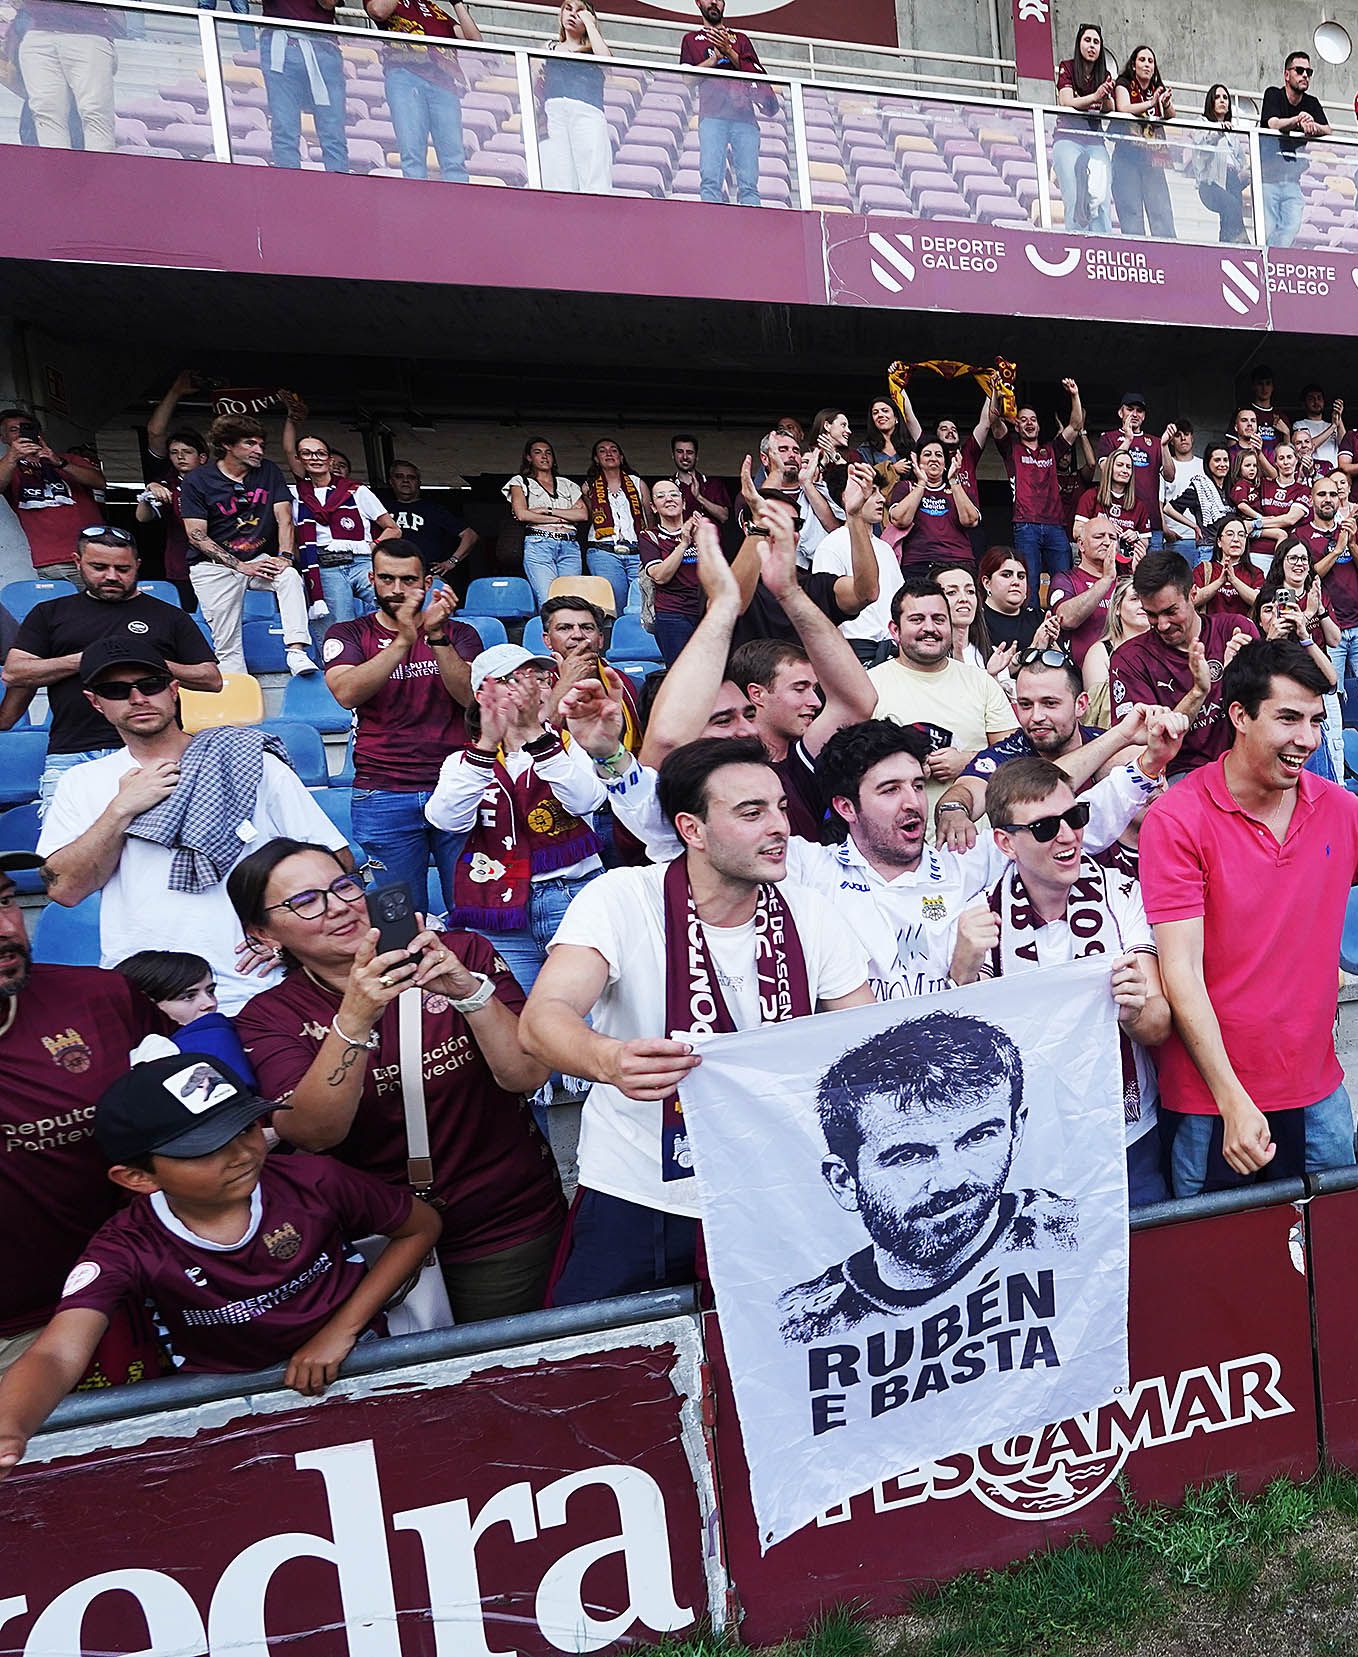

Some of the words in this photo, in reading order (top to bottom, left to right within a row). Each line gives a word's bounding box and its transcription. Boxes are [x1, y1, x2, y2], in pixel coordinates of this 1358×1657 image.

[921, 236, 1006, 257] DEPORTE
[922, 253, 999, 274] GALEGO
[1085, 248, 1147, 269] GALICIA
[1087, 264, 1166, 285] SAUDABLE
[1267, 263, 1337, 281] DEPORTE
[1268, 278, 1330, 297] GALEGO
[808, 1268, 1056, 1392] RUBÉN
[811, 1392, 848, 1437] E
[879, 1325, 1061, 1413] BASTA
